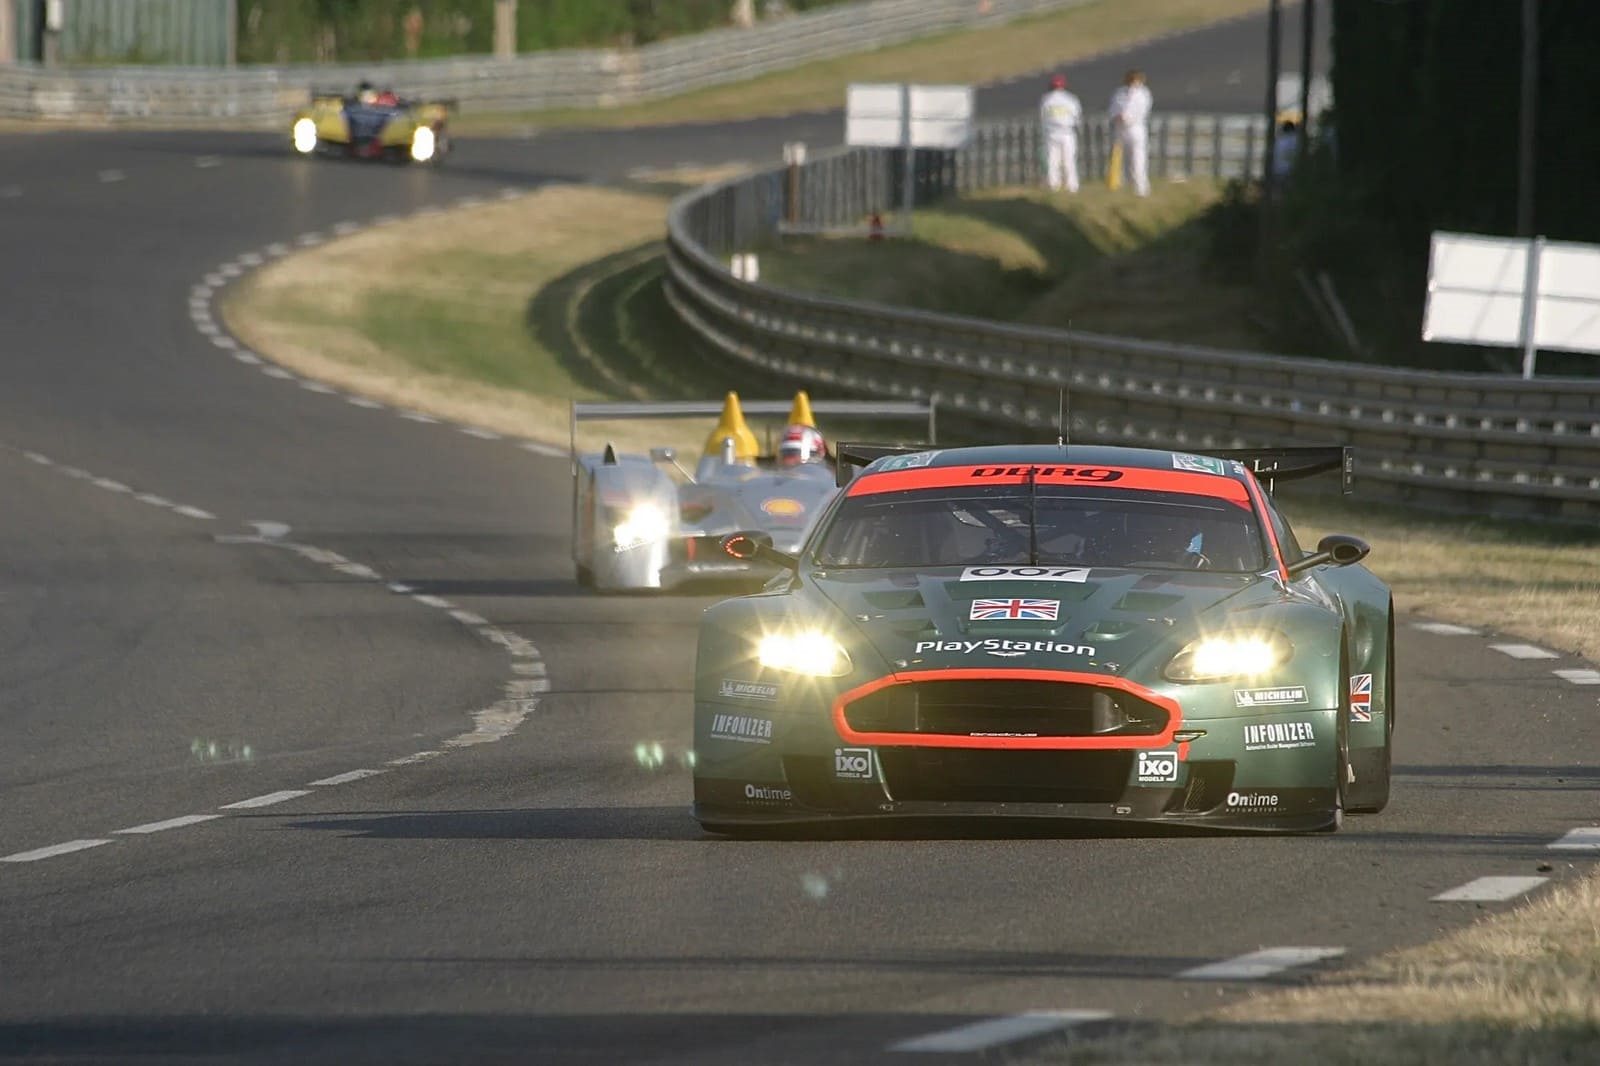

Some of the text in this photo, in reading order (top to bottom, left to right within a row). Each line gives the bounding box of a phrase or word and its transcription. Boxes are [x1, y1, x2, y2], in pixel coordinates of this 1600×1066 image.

[971, 467, 1124, 482] DBR9
[970, 568, 1082, 577] 007
[915, 638, 1096, 657] PlayStation
[1254, 690, 1303, 701] MICHELIN
[711, 714, 773, 738] INFONIZER
[1244, 722, 1315, 744] INFONIZER
[744, 783, 792, 800] Ontime
[1227, 792, 1279, 806] Ontime
